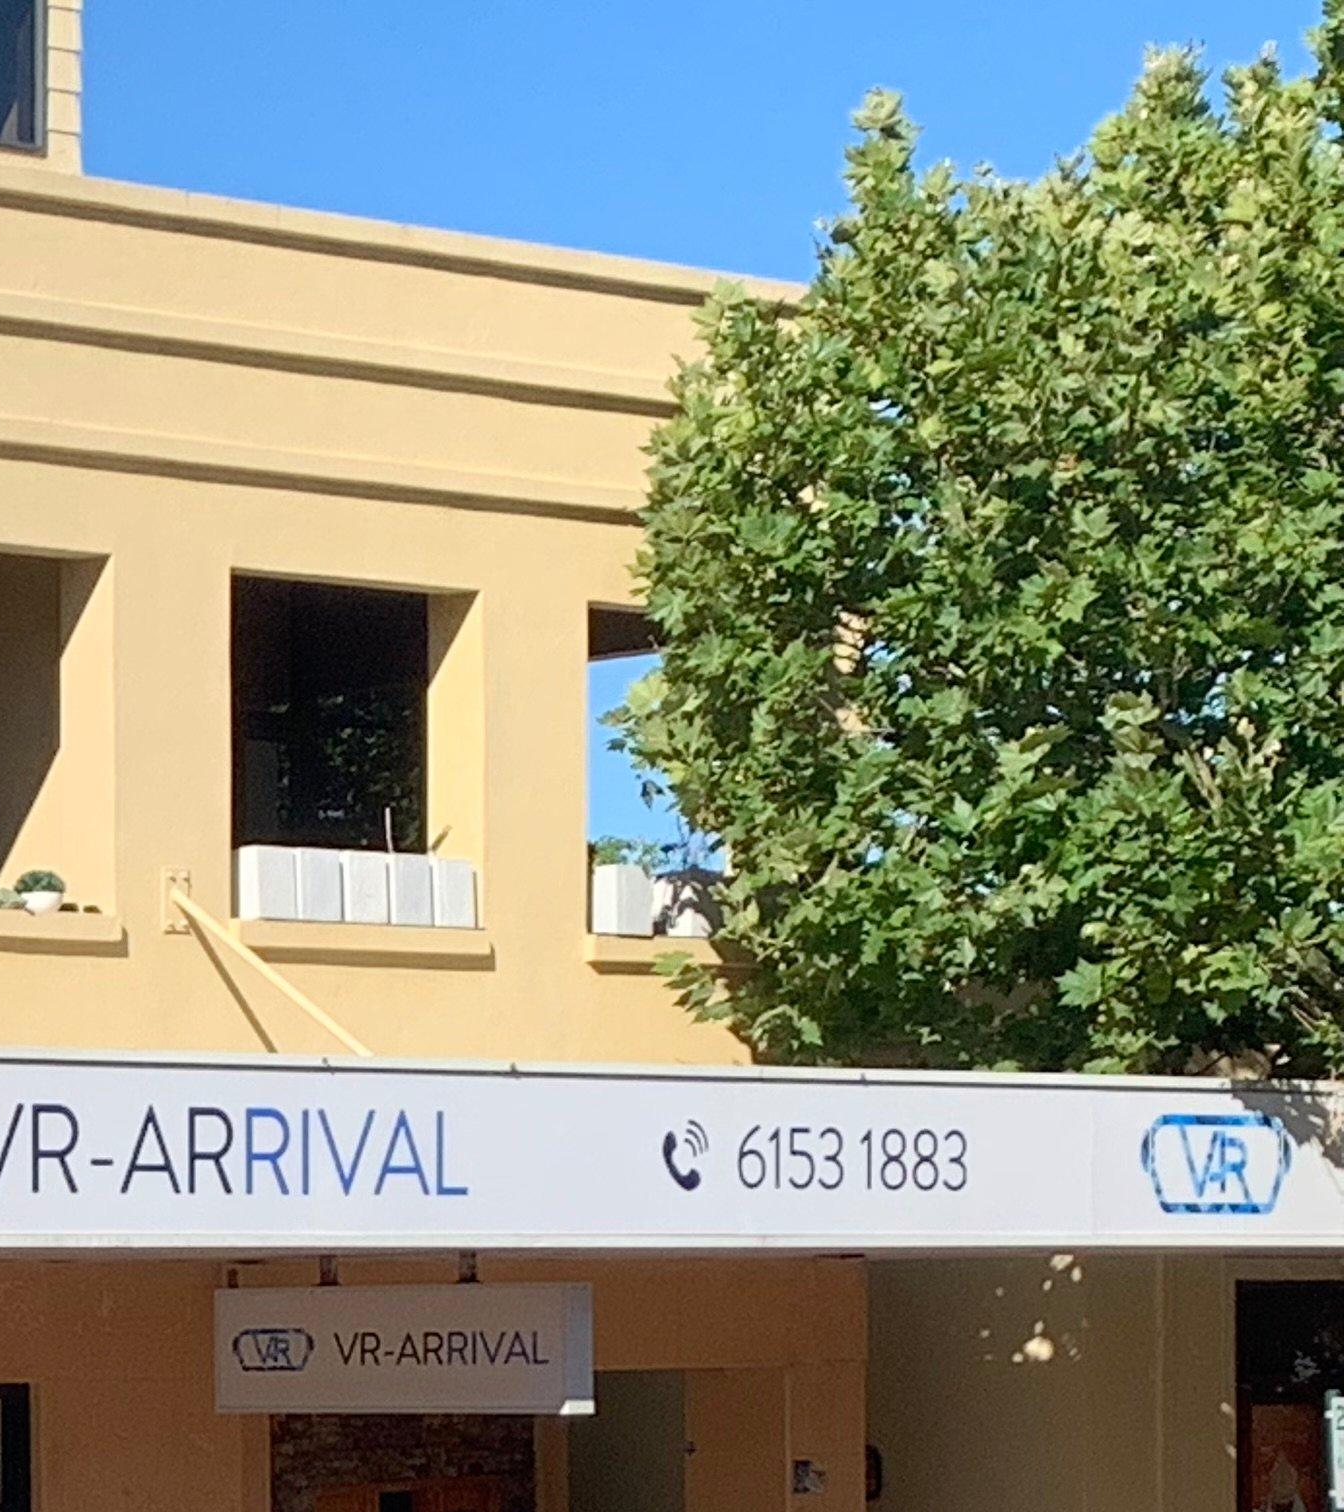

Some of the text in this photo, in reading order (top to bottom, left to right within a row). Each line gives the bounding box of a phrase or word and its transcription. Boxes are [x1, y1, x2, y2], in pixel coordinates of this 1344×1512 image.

[737, 1123, 968, 1192] 6153 1883
[333, 1330, 550, 1366] VR-ARRIVAL
